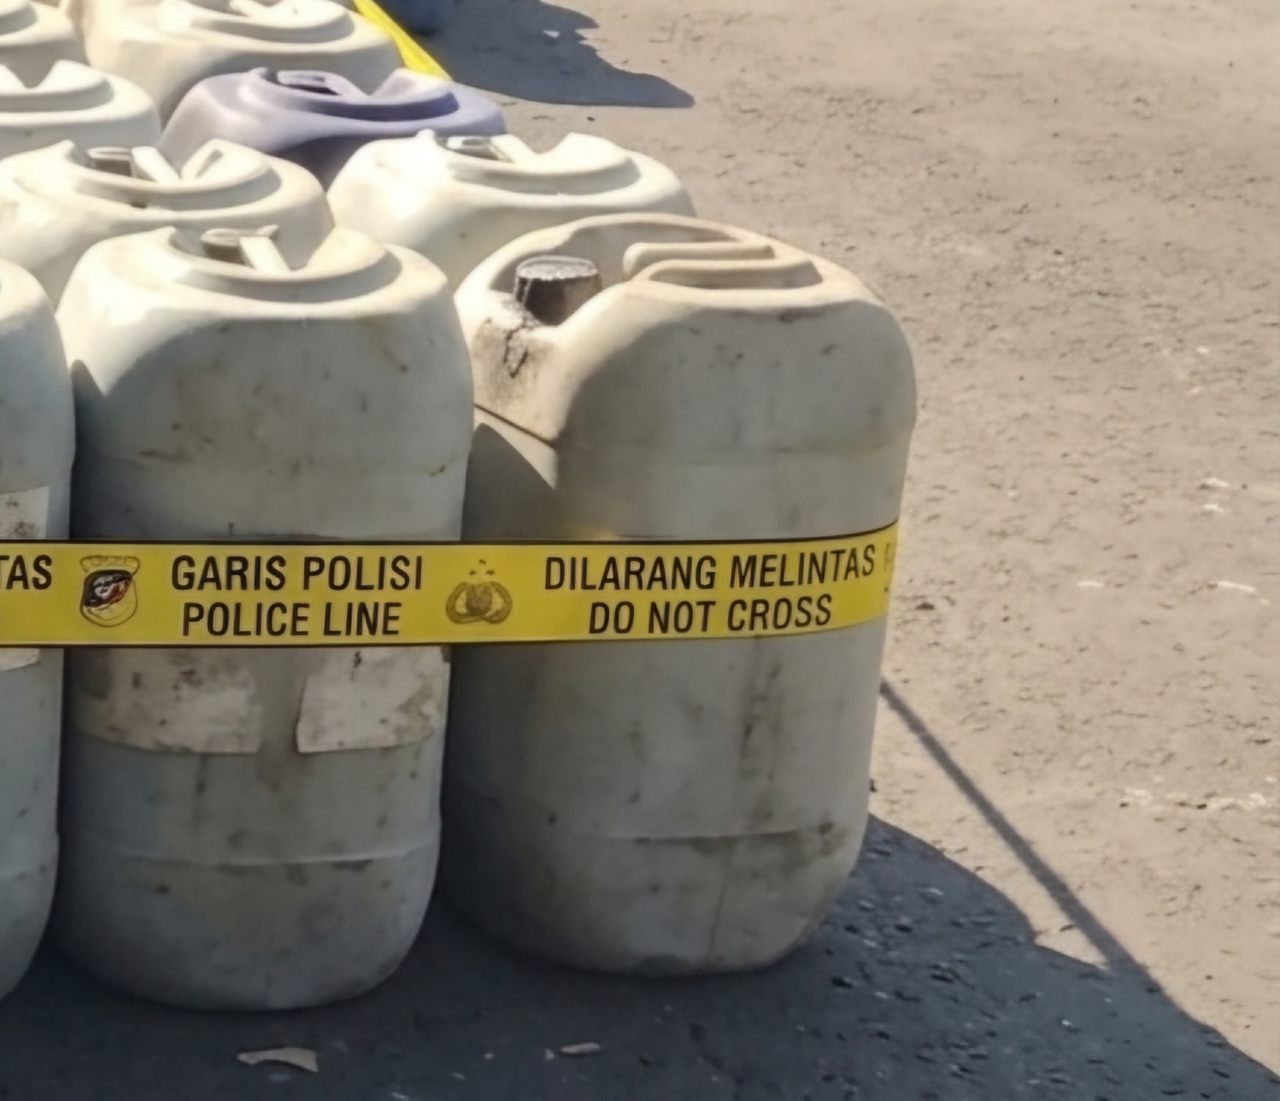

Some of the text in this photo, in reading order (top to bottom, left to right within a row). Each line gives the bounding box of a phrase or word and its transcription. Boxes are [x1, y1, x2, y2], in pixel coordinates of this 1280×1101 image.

[171, 554, 423, 592] GARIS POLISI
[544, 555, 717, 591] DILARANG
[729, 543, 876, 590] MELINTAS
[182, 601, 403, 637] POLICE LINE
[589, 593, 833, 635] DO NOT CROSS
